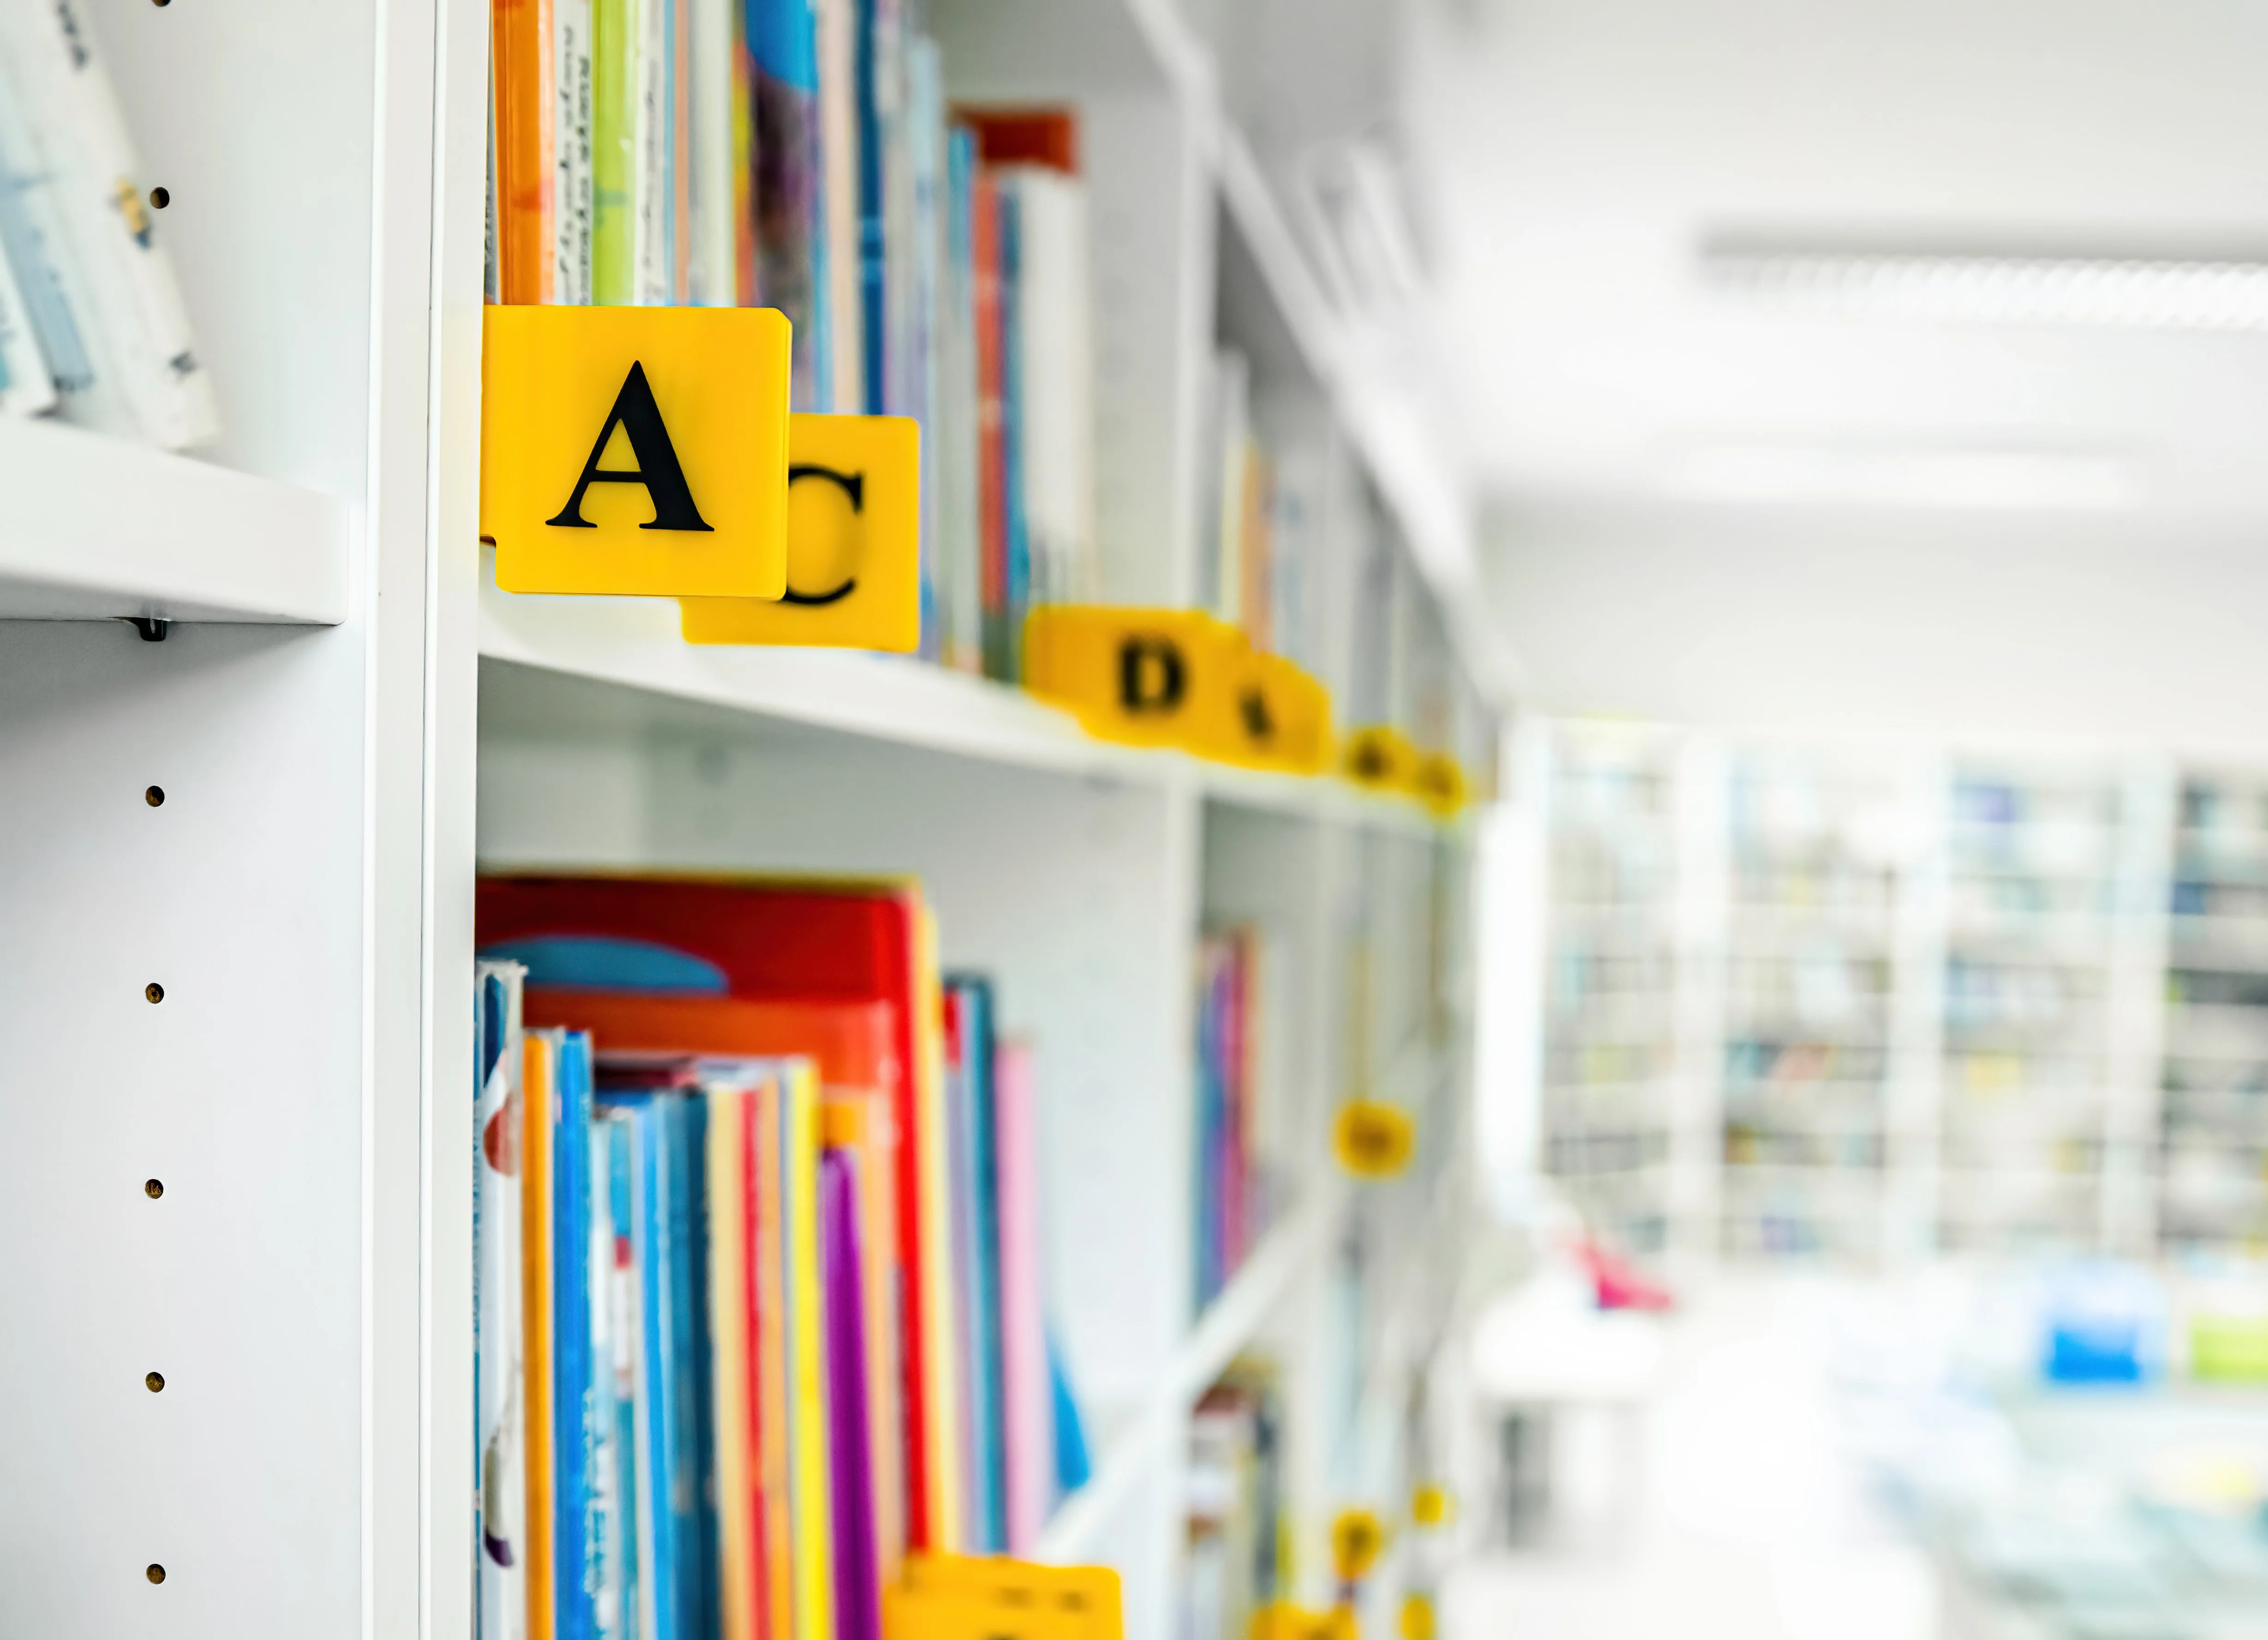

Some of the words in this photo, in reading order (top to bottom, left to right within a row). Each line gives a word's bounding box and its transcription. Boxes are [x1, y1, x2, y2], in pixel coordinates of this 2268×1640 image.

[545, 360, 714, 532] A
[783, 463, 864, 607] C
[1116, 635, 1190, 715] D
